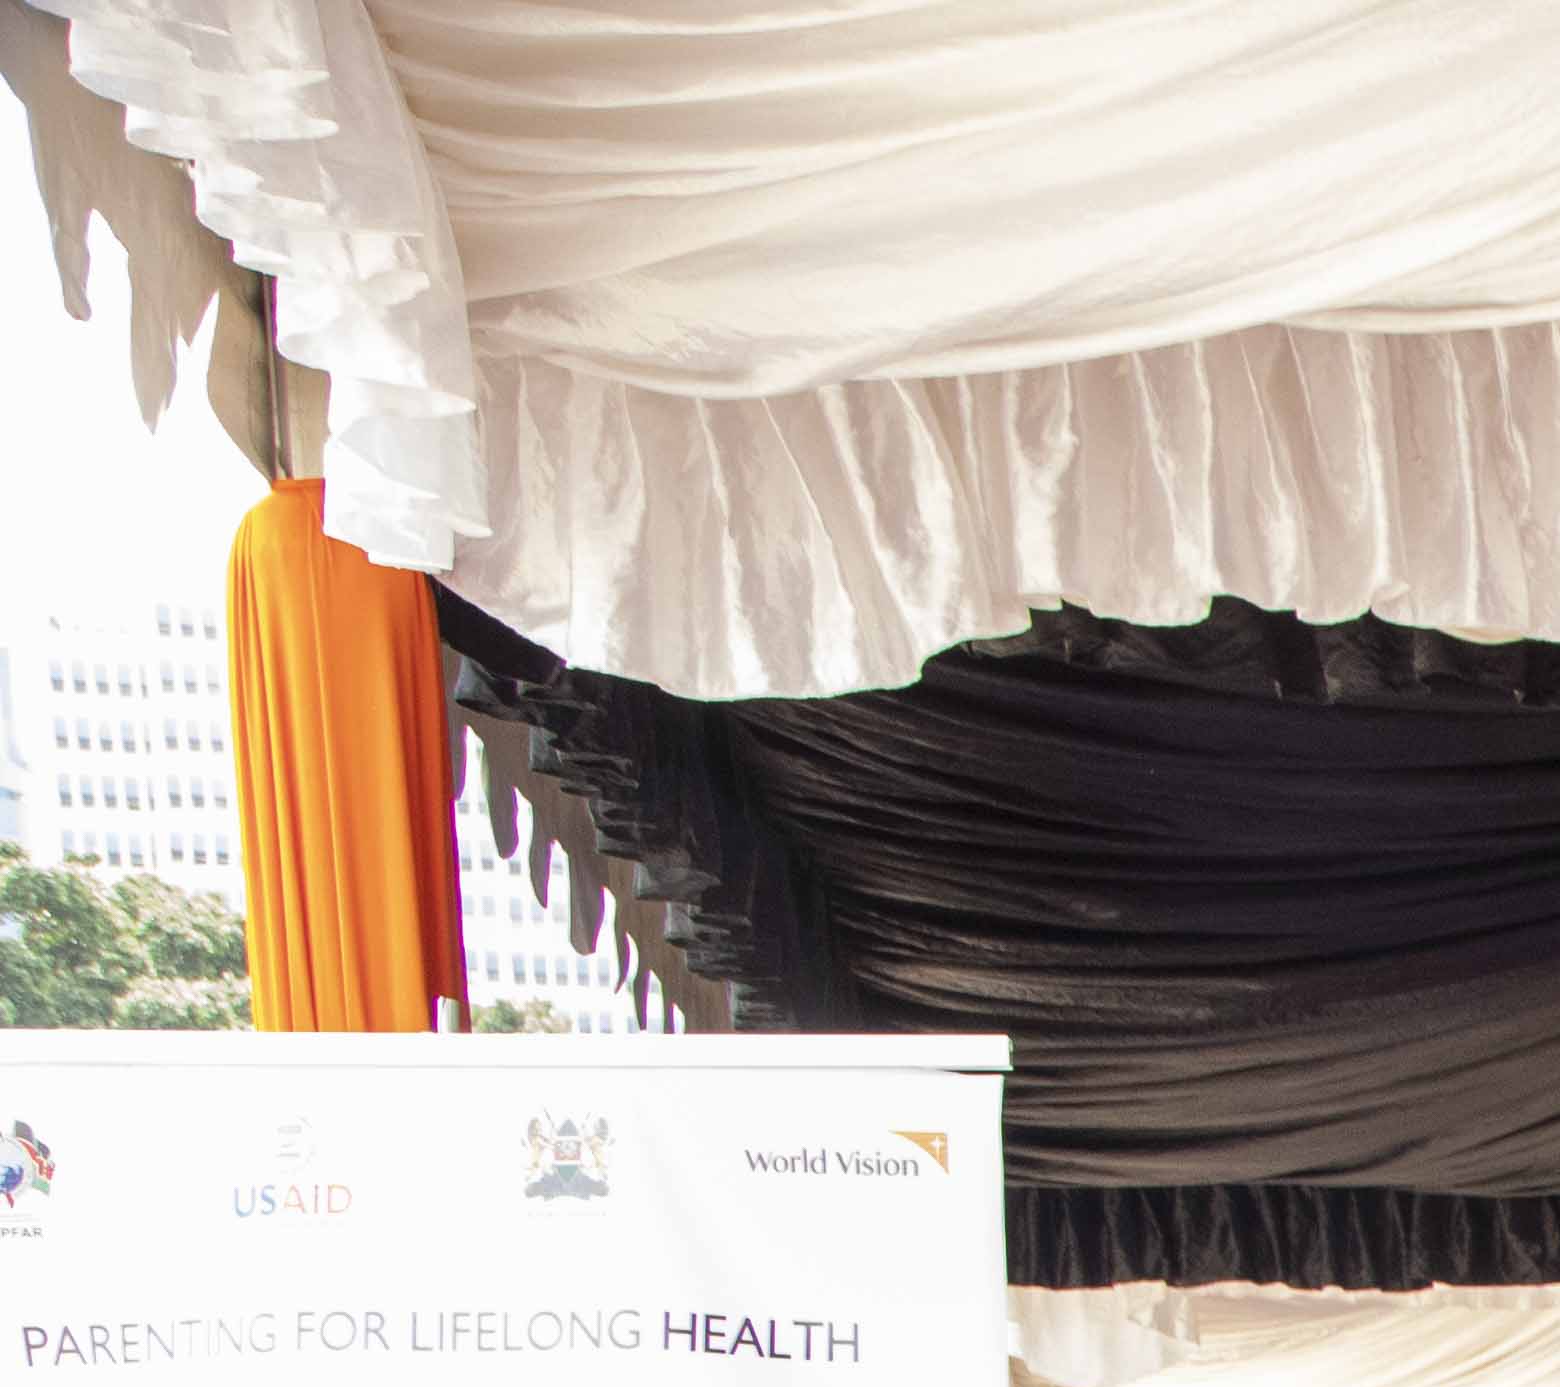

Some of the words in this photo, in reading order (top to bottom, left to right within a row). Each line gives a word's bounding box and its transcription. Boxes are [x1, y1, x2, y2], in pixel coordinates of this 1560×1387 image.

[744, 1148, 827, 1176] World
[835, 1150, 920, 1177] Vision
[233, 1184, 353, 1217] USAID
[21, 1312, 277, 1367] PARENTING
[297, 1310, 391, 1352] FOR
[410, 1309, 641, 1353] LIFELONG
[662, 1310, 860, 1363] HEALTH
